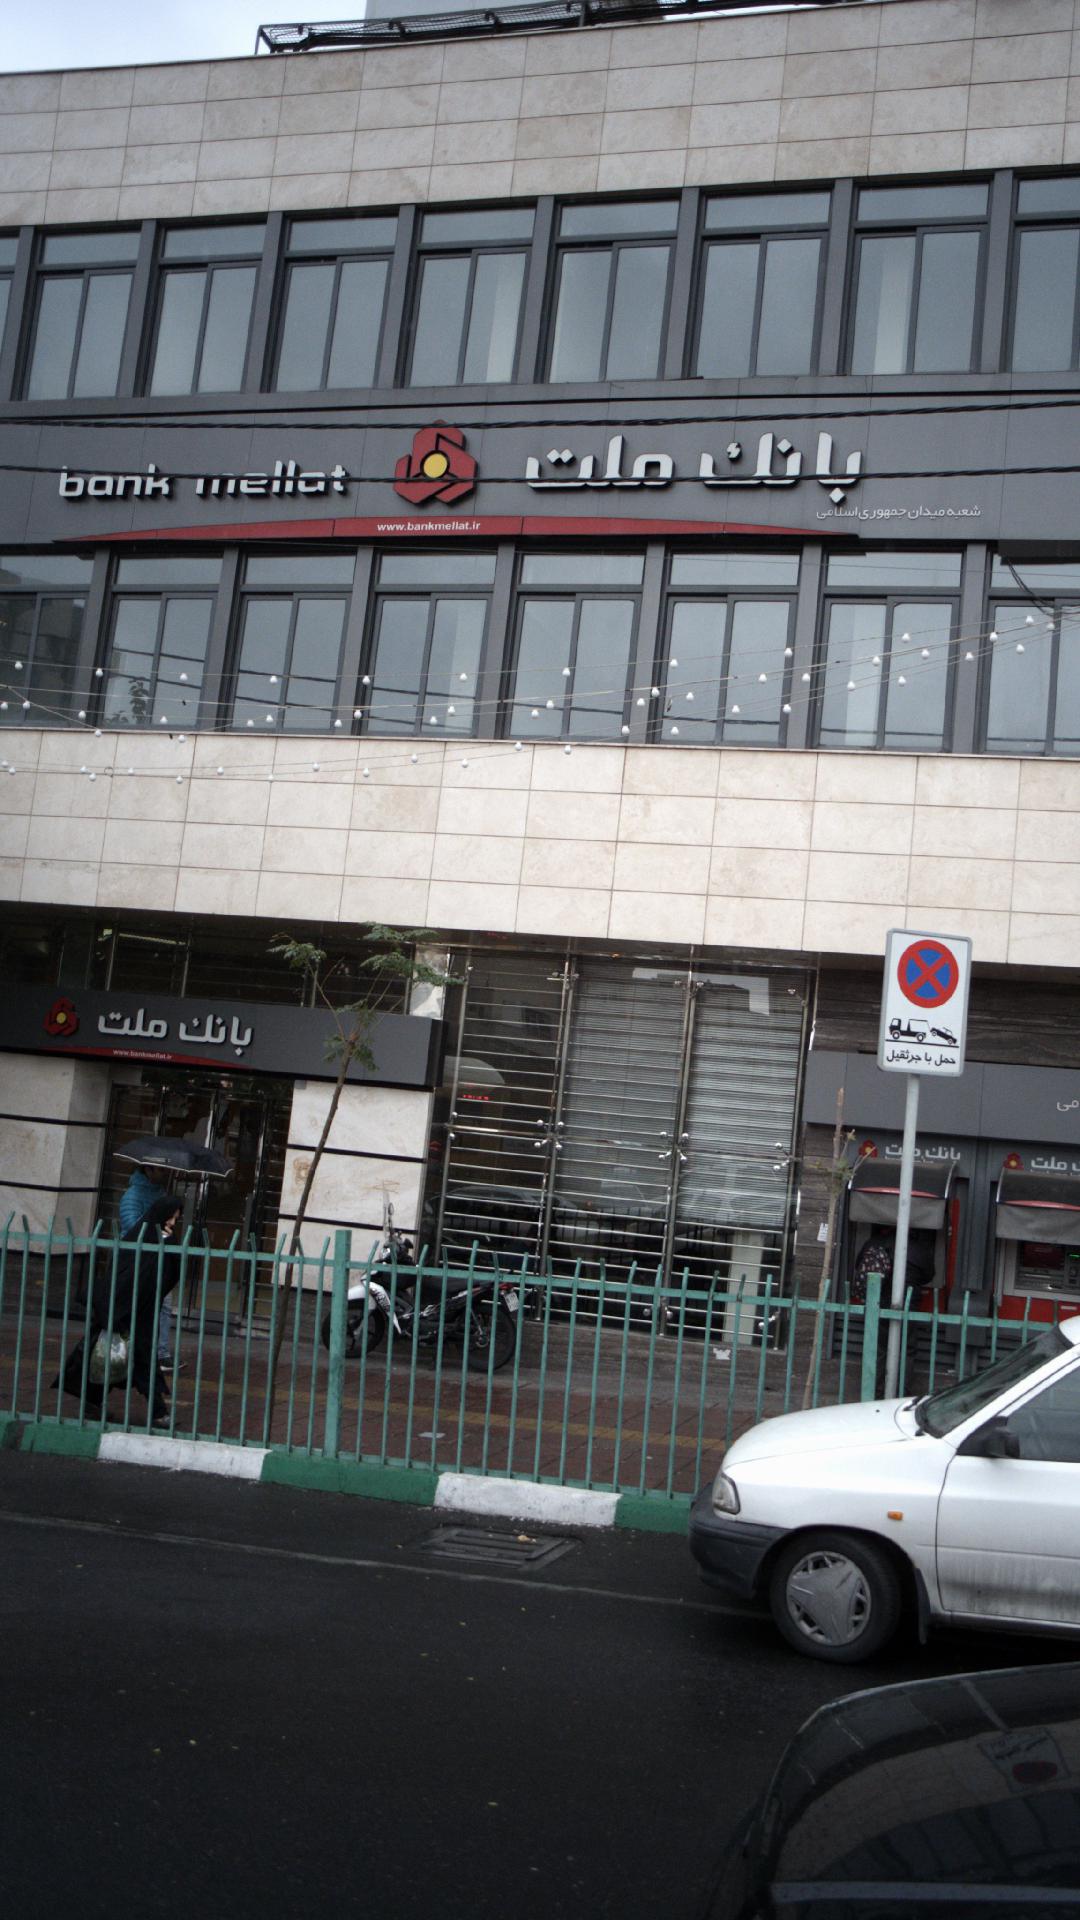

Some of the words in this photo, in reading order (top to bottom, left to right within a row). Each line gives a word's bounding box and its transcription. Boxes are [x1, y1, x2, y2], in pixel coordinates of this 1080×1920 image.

[525, 434, 675, 488] ملت
[59, 464, 170, 497] bank
[195, 460, 346, 495] mellat
[907, 505, 945, 520] میدان
[377, 521, 481, 531] www.bankmellat.ir
[98, 1008, 168, 1038] ملت
[886, 1049, 921, 1062] جرثقیل
[924, 1052, 931, 1065] با
[934, 1054, 956, 1066] حمل
[1031, 1156, 1067, 1171] ملت
